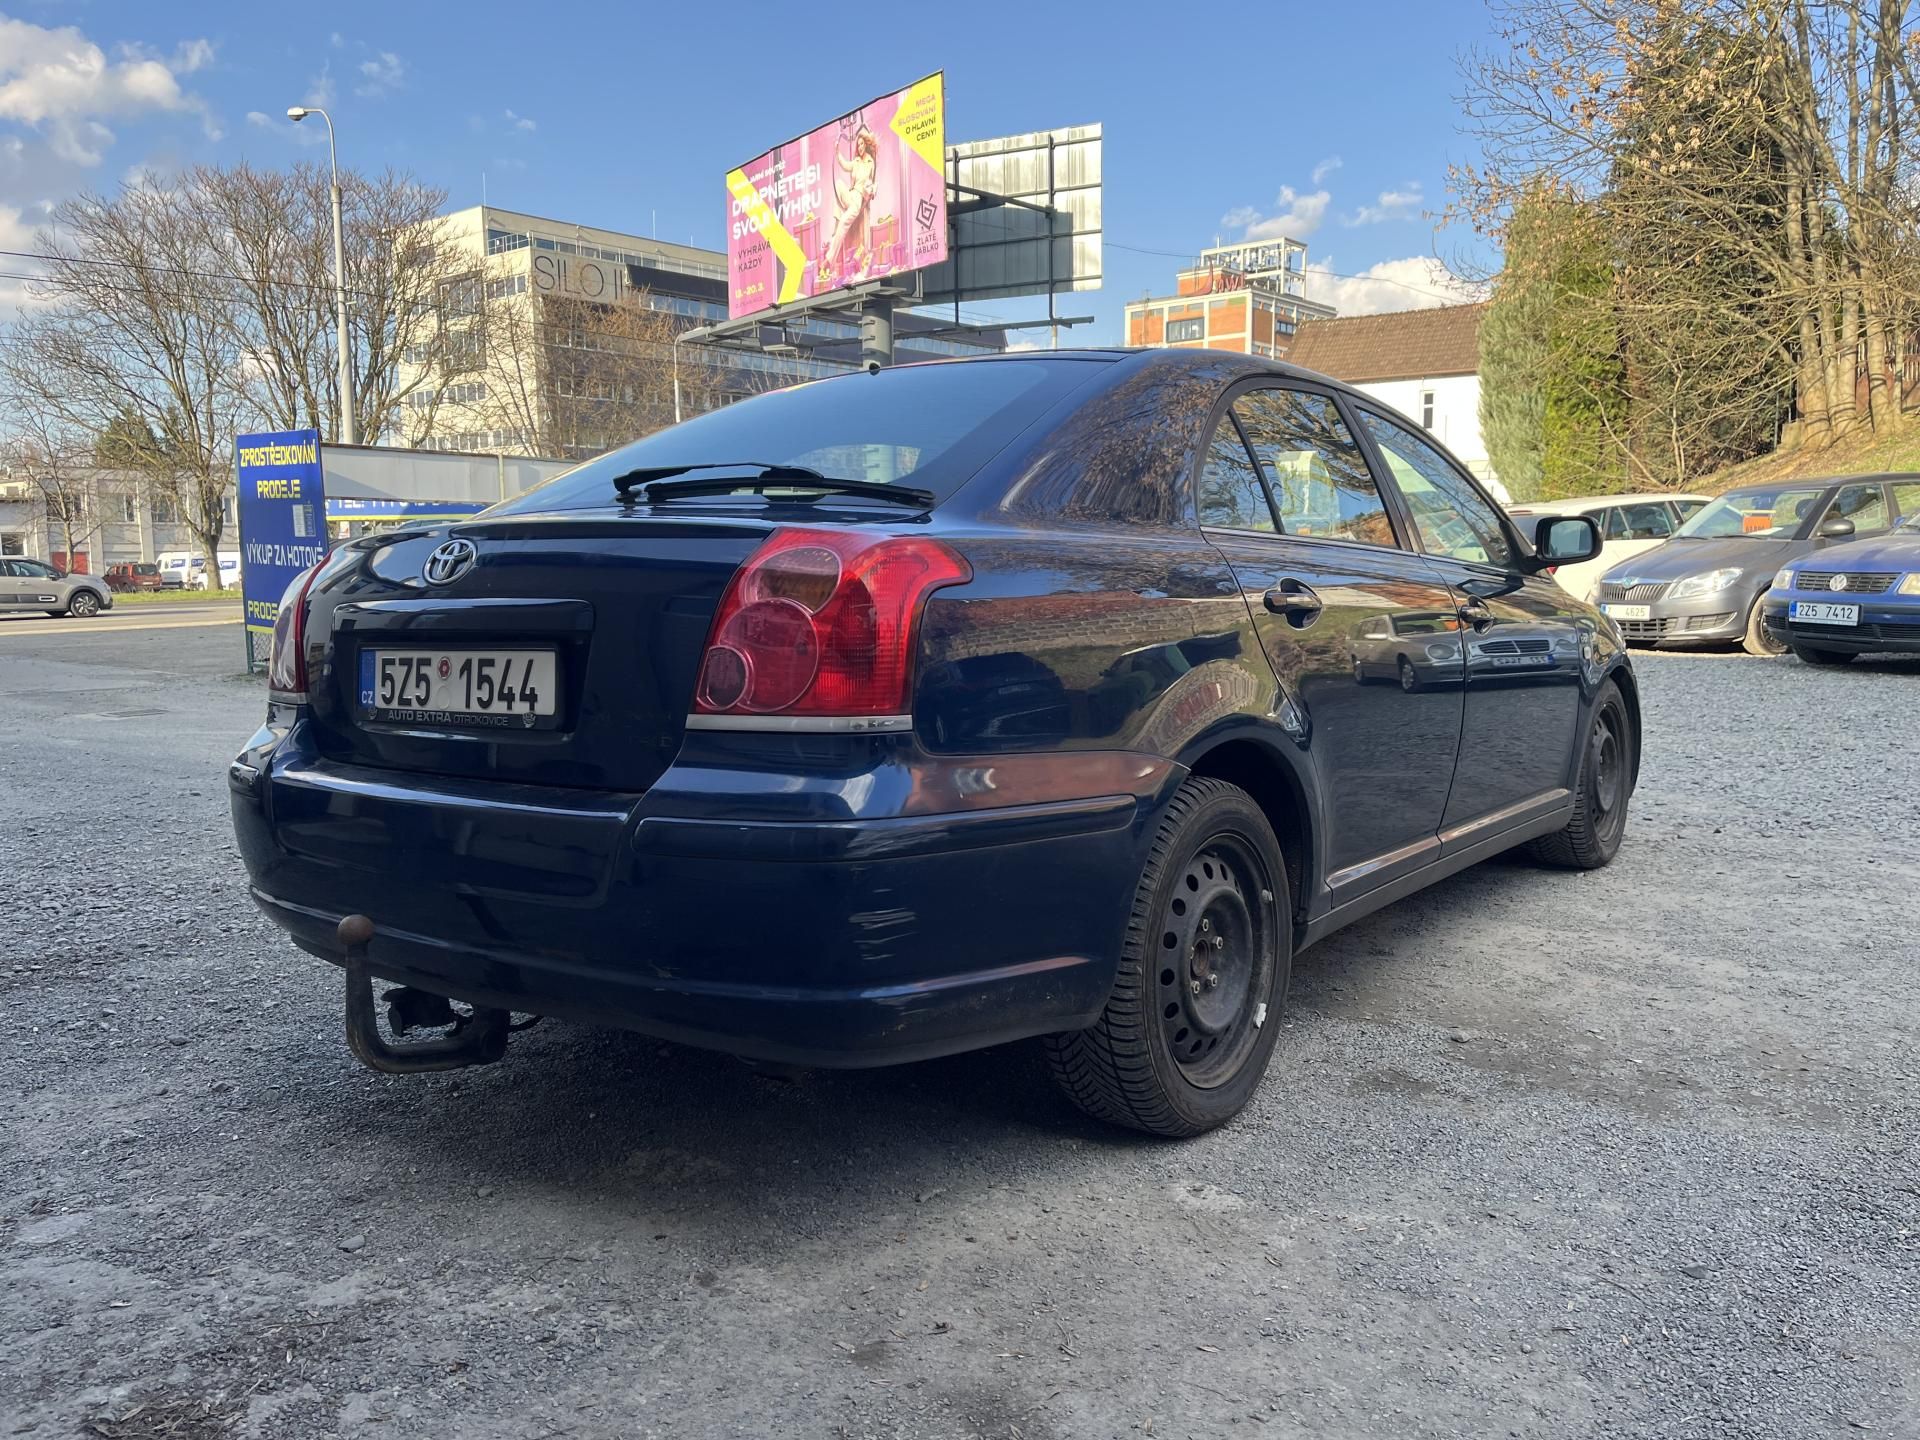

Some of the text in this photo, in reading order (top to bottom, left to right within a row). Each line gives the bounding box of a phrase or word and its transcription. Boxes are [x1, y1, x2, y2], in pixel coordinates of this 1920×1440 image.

[912, 114, 936, 132] HLAVNÍ
[805, 163, 820, 185] SI
[773, 188, 822, 220] VÝHRU
[917, 231, 937, 246] ZLATÉ
[915, 242, 939, 256] JABLKO
[534, 256, 604, 297] SILO
[239, 438, 317, 467] ZPROSTŘEDKOVÁNÍ
[256, 479, 301, 499] PRODEJE
[246, 538, 323, 568] VÝKUP ZA HOTOVÉ
[1625, 607, 1646, 617] 4625
[1799, 605, 1853, 619] 2Z5 7412
[381, 657, 538, 711] 5Z5 1544
[361, 691, 373, 704] CZ
[388, 710, 508, 726] AUTO EXTRA OTROKOVICE
